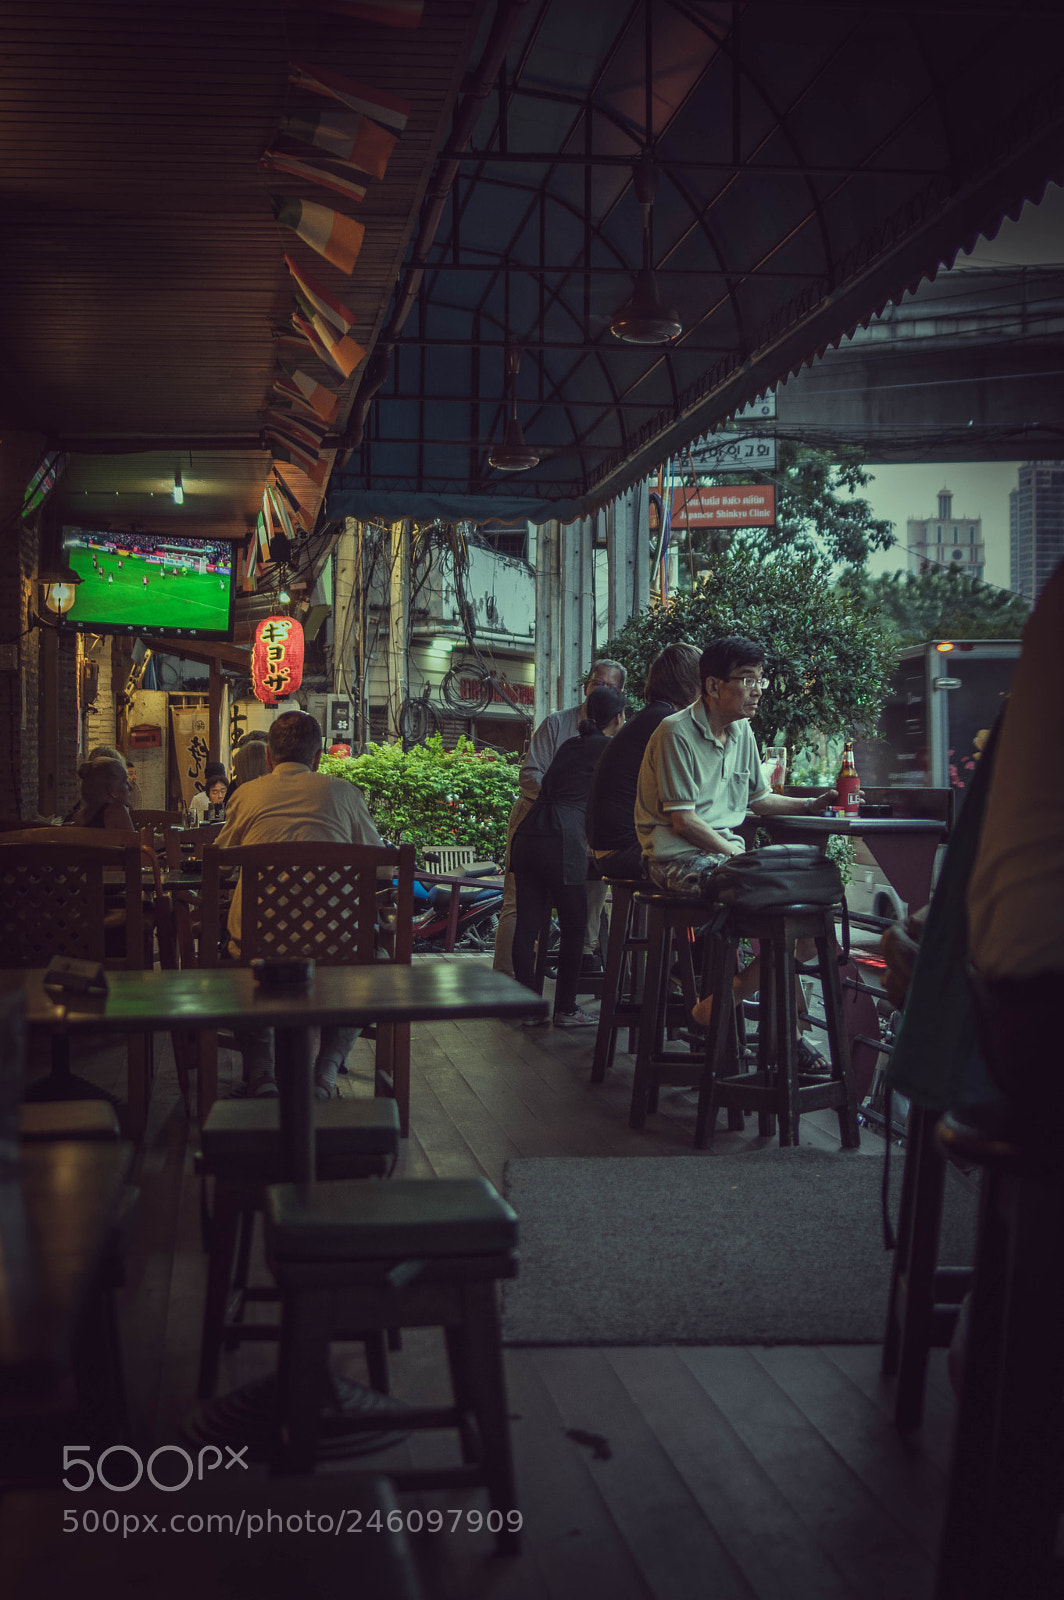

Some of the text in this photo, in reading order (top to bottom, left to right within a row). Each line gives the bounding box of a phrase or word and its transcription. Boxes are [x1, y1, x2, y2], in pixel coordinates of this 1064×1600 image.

[680, 508, 770, 521] Japanese Shinkyu Clinic
[261, 622, 291, 692] ギョーザ
